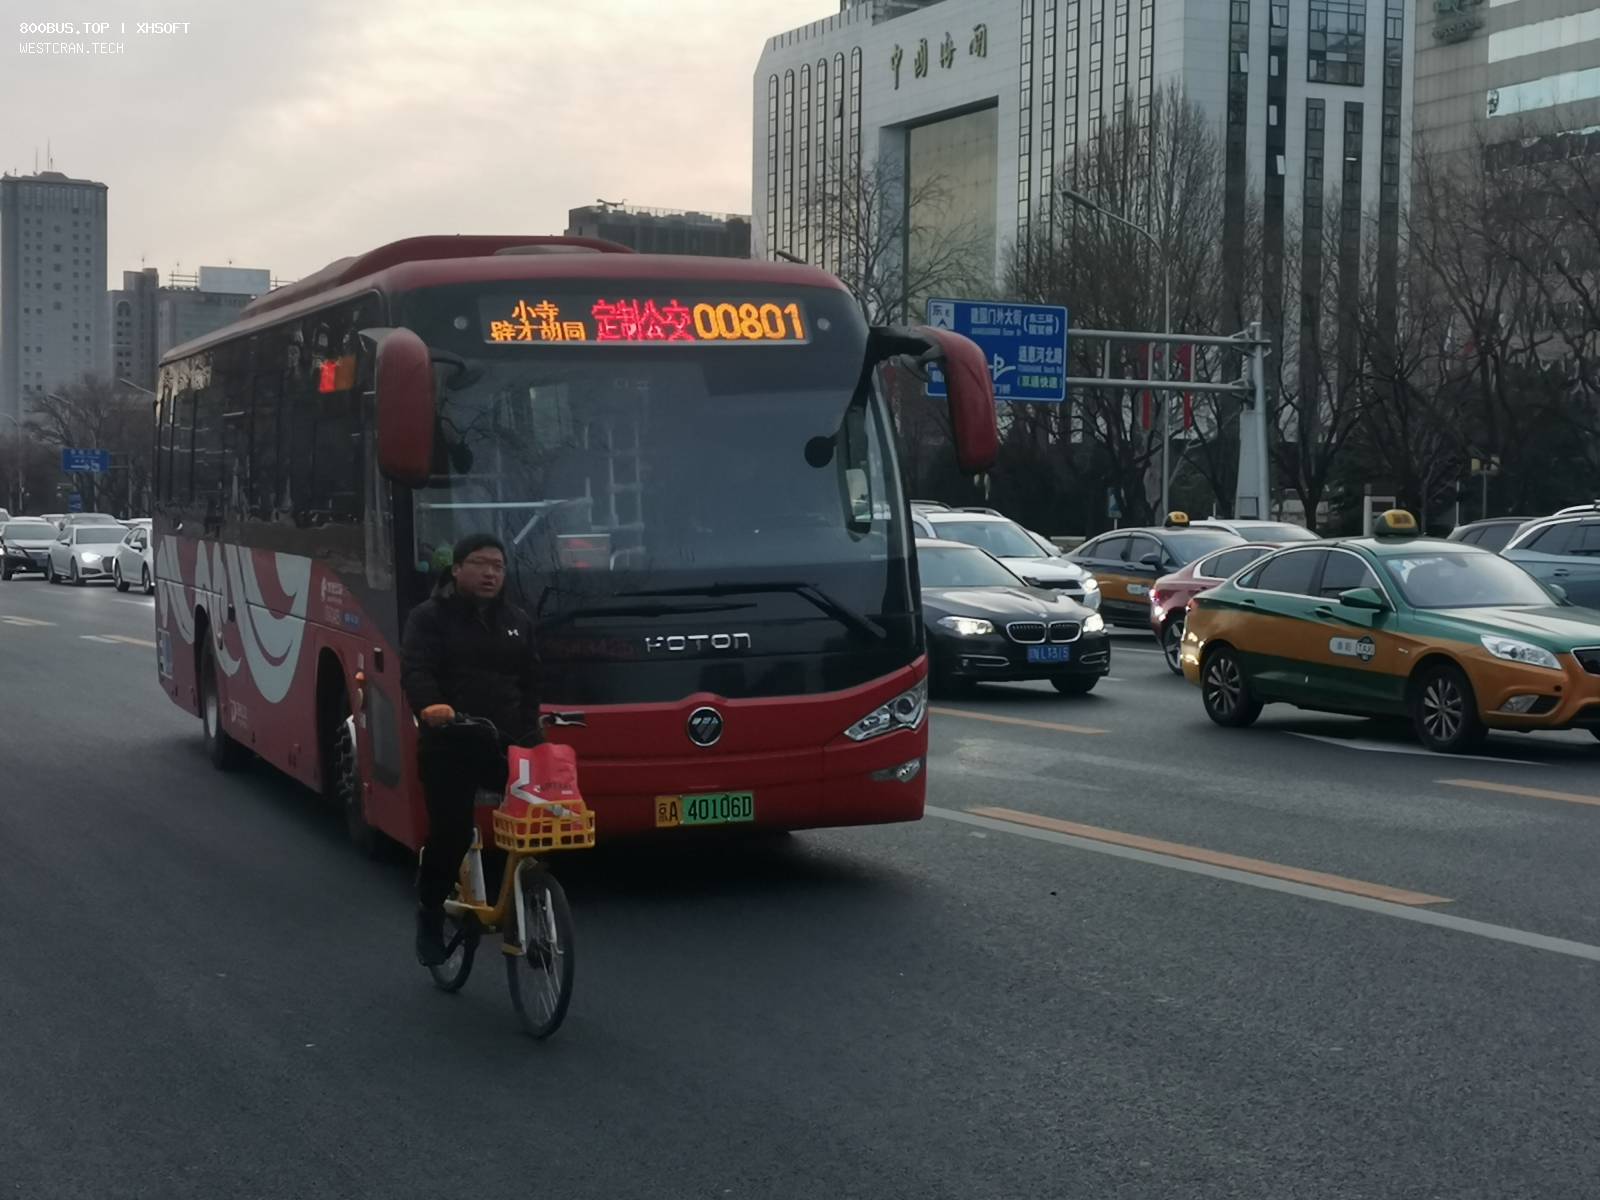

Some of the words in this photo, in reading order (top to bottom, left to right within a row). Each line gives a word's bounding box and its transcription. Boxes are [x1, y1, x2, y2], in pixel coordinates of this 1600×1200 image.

[512, 299, 560, 322] 小寺
[591, 298, 695, 342] 定制公交
[693, 303, 804, 340] 00801
